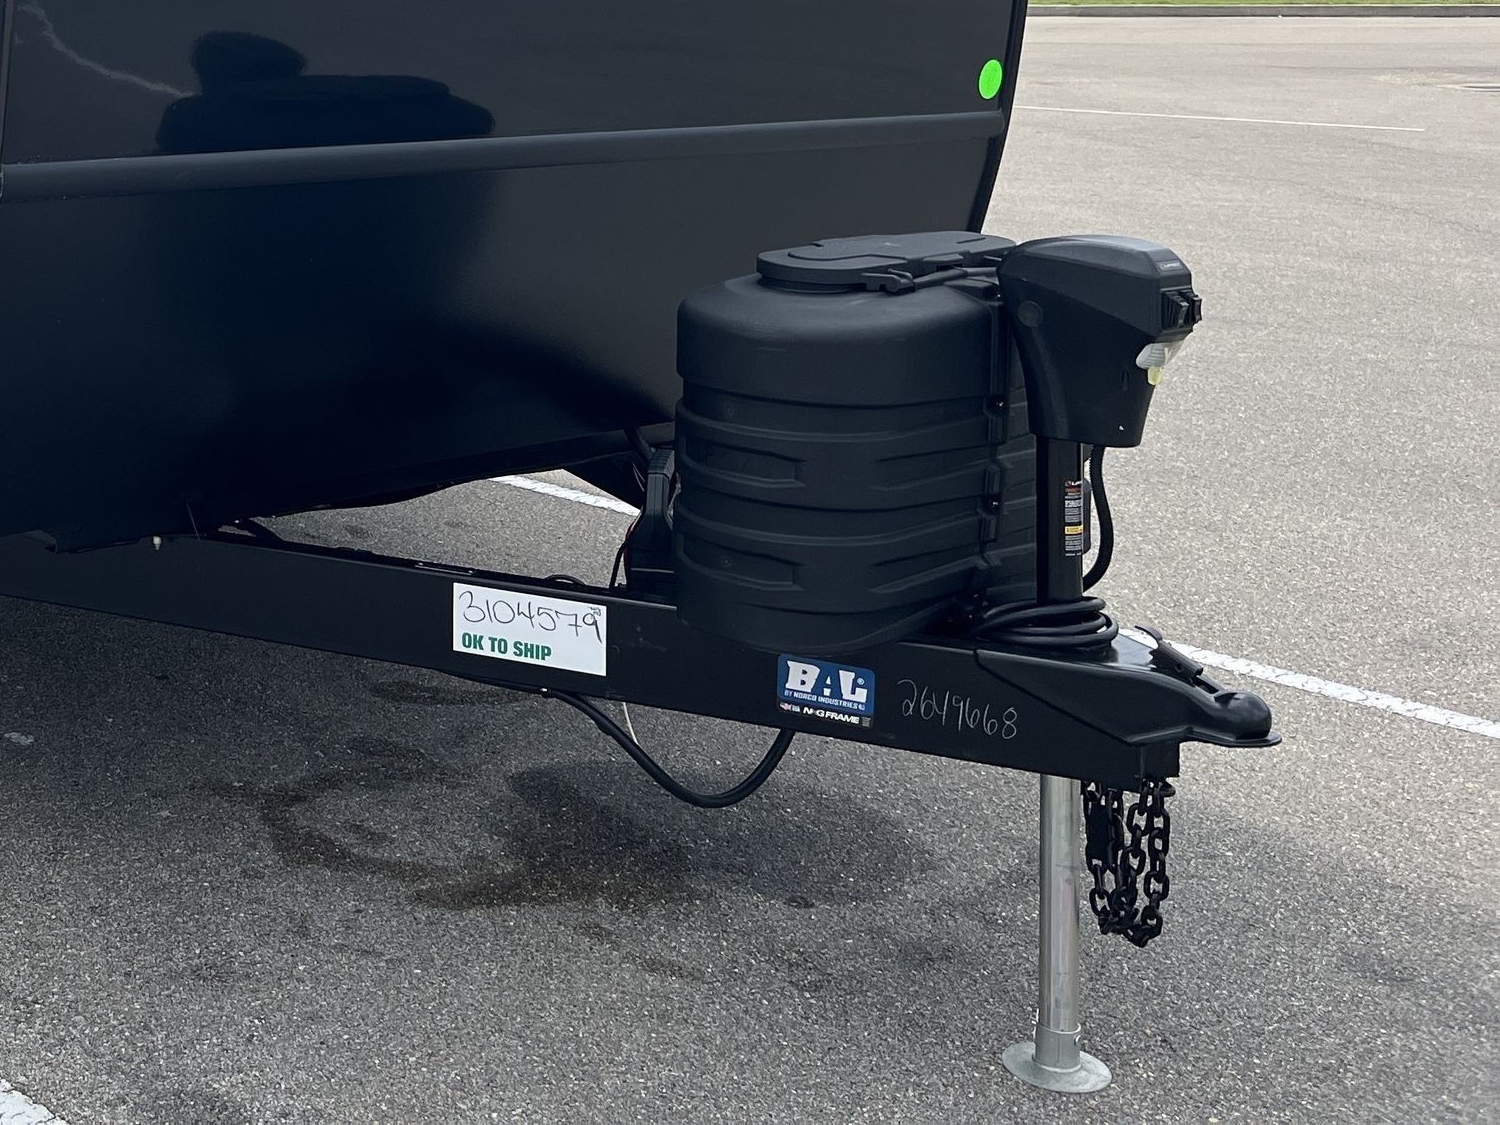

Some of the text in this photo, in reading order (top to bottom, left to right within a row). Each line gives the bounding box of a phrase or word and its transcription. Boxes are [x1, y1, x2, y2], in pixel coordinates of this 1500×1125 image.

[458, 590, 603, 643] 3104579
[461, 632, 552, 661] OK TO SHIP
[784, 689, 858, 710] BY NORCO INDUSTRIES
[785, 660, 868, 703] BAL
[896, 678, 1018, 740] 2649668
